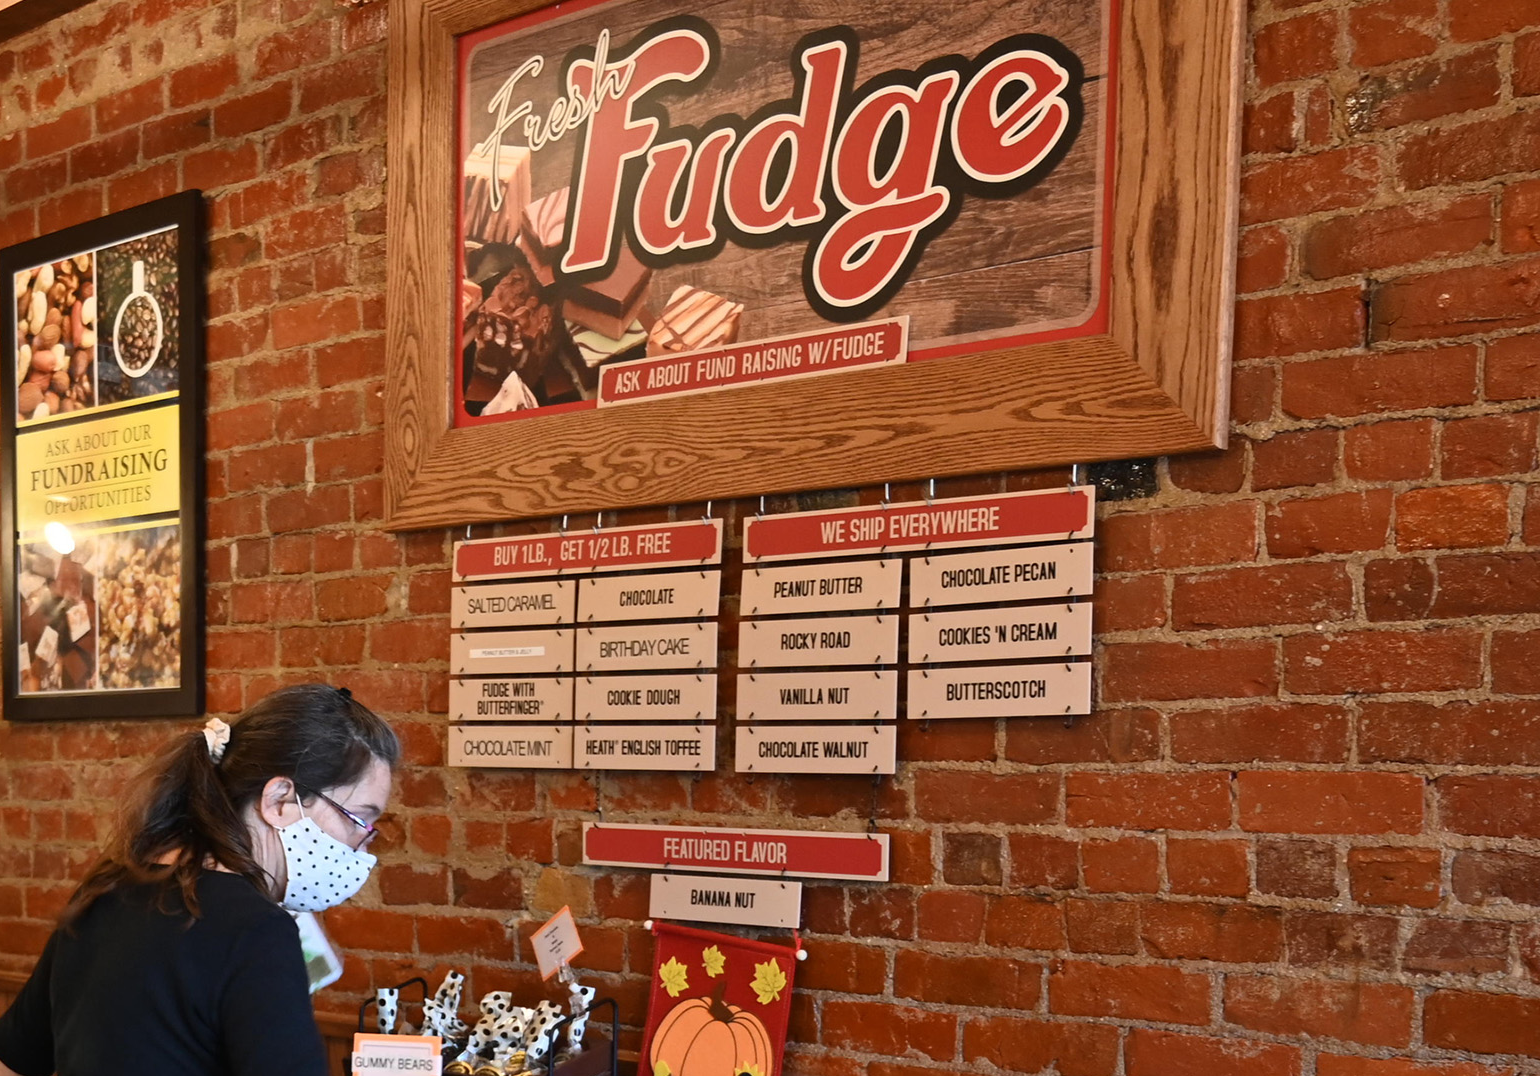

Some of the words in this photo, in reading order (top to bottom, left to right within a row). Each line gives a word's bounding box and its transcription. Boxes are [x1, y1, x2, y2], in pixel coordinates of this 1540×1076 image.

[481, 27, 636, 211] Fresh
[560, 28, 1070, 310] Fudge
[614, 370, 641, 394] ASK
[646, 362, 691, 389] ABOUT
[696, 357, 736, 382] FUND
[742, 344, 802, 375] RAISING
[808, 331, 885, 365] W/FUDGE
[45, 439, 70, 458] ASK
[74, 430, 119, 452] ABOUT
[122, 424, 152, 443] OUR
[31, 448, 168, 491] FUNDRAISING
[44, 485, 152, 515] OPPORTUNITIES
[821, 520, 845, 545] WE
[850, 516, 885, 542] SHIP
[889, 506, 1000, 540] EVERYWHERE
[494, 545, 518, 566] BUY
[560, 539, 585, 561] GET
[588, 537, 610, 561] 1/2
[612, 536, 633, 558] LB.
[636, 532, 671, 554] FREE
[941, 566, 1010, 589] CHOCOLATE
[1014, 561, 1056, 584] PECAN
[619, 588, 674, 607] CHOCOLATE
[773, 579, 816, 599] PEANUT
[819, 577, 863, 596] BUTTER
[468, 596, 506, 615] SALTED
[507, 593, 556, 612] CARAMEL
[781, 632, 817, 650] ROCKY
[820, 630, 851, 649] ROAD
[939, 626, 991, 646] COOKIES
[995, 624, 1007, 644] 'N
[1011, 622, 1057, 642] CREAM
[600, 640, 657, 658] BIRTHDAY
[658, 638, 690, 656] CAKE
[482, 683, 509, 698] FUDGE
[512, 682, 535, 697] WITH
[607, 690, 642, 706] COOKIE
[646, 689, 680, 705] DOUGH
[780, 689, 823, 705] VANILLA
[828, 687, 849, 704] NUT
[947, 680, 1046, 701] BUTTERSCOTCH
[464, 740, 526, 757] CHOCOLATE
[527, 740, 552, 757] MINT
[621, 740, 661, 756] ENGLISH
[664, 740, 701, 756] TOFFEE
[759, 741, 819, 758] CHOCOLATE
[822, 741, 868, 758] WALNUT
[663, 837, 730, 861] FEATURED
[734, 840, 787, 864] FLAVOR
[691, 889, 732, 908] BANANA
[735, 892, 755, 909] NUT
[354, 1056, 395, 1069] GUMMY
[397, 1058, 433, 1071] BEARS
